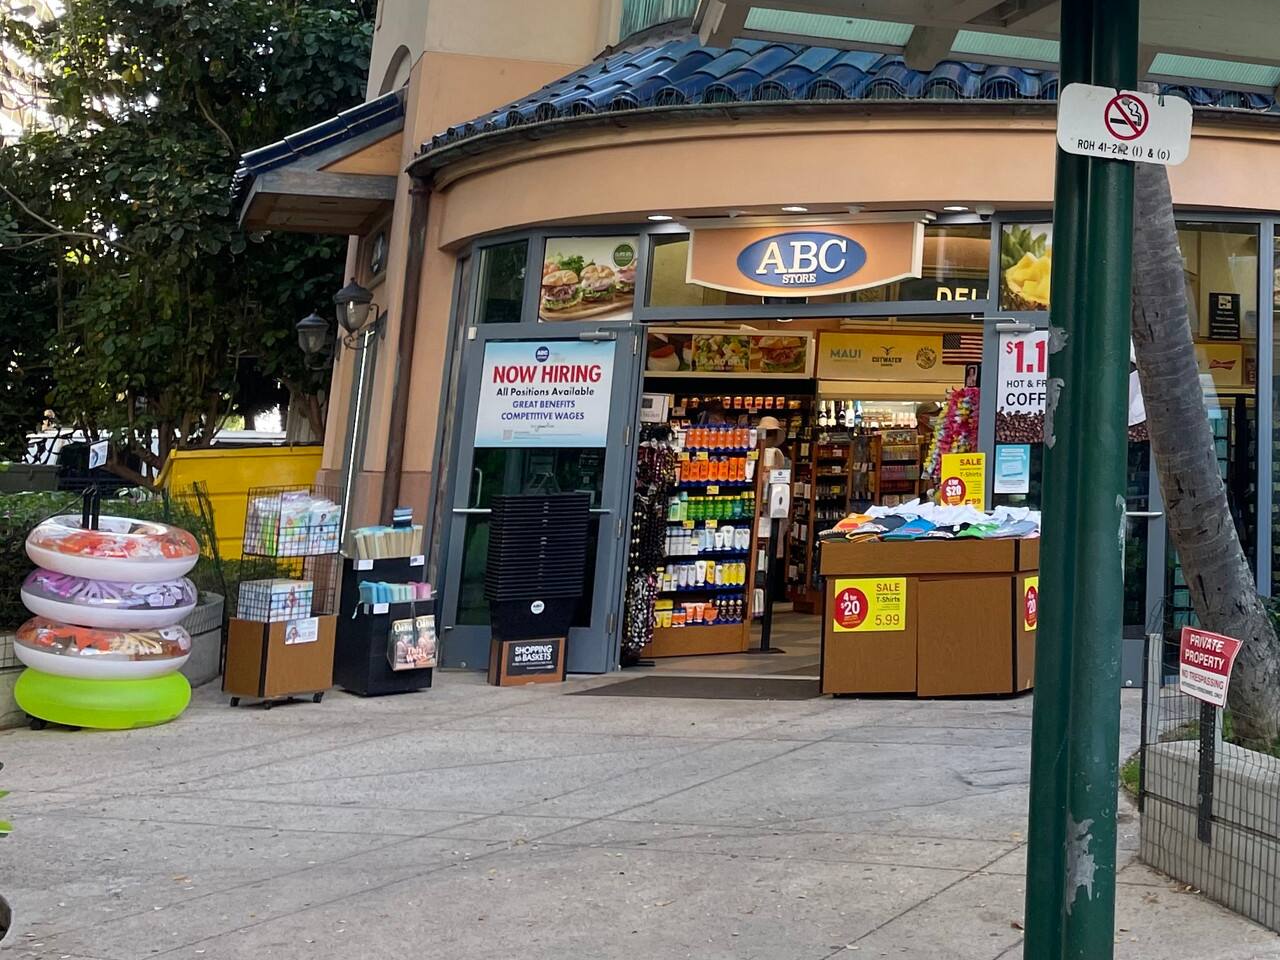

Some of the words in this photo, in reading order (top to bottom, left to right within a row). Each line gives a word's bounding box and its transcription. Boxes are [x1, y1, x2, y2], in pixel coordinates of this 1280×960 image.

[1077, 139, 1095, 151] ROH
[1148, 148, 1154, 158] &
[755, 239, 848, 275] ABC
[782, 273, 816, 284] STORE
[830, 348, 862, 359] MAUI
[1006, 339, 1046, 373] $1.1
[493, 365, 538, 384] NOW
[541, 365, 602, 383] HIRING
[1006, 380, 1025, 388] HOT
[1027, 380, 1034, 388] &
[496, 387, 509, 396] All
[510, 387, 549, 396] Positions
[551, 386, 595, 396] Available
[512, 400, 538, 409] GREAT
[540, 400, 576, 408] BENEFITS
[1005, 392, 1046, 406] COFF
[501, 412, 553, 420] COMPETITIVE
[554, 411, 585, 420] WAGES
[960, 458, 982, 466] SALE
[876, 582, 900, 592] SALE
[843, 592, 849, 601] 4
[875, 595, 900, 603] T-Shirts
[840, 600, 860, 616] $20
[875, 614, 900, 626] 5.99
[1190, 634, 1225, 653] PRIVATE
[514, 645, 553, 655] SHOPPING
[522, 652, 552, 662] BASKETS
[1185, 648, 1225, 671] PROPERTY
[1188, 670, 1225, 690] TRESPASSING
